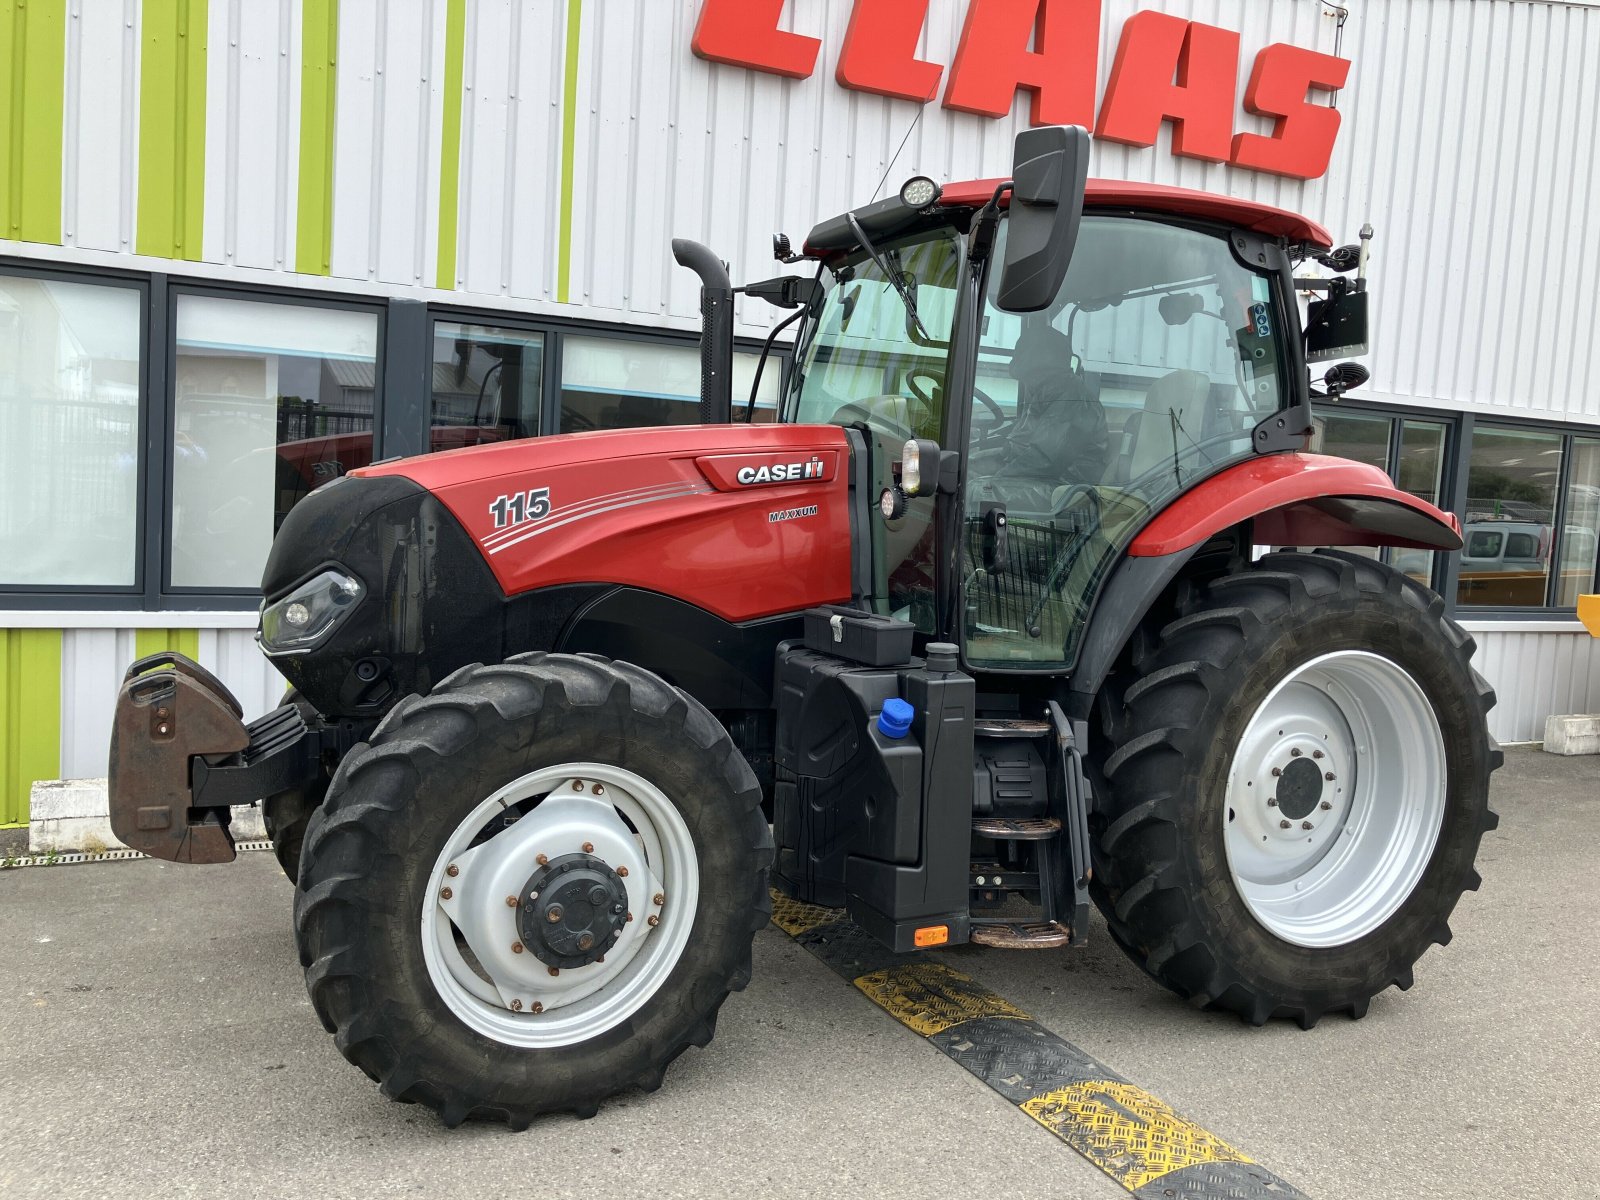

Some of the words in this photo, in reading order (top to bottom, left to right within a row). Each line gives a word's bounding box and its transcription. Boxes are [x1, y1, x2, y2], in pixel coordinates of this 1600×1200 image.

[737, 463, 801, 485] CASE
[489, 487, 551, 529] 115
[769, 505, 818, 523] MAXXUM
